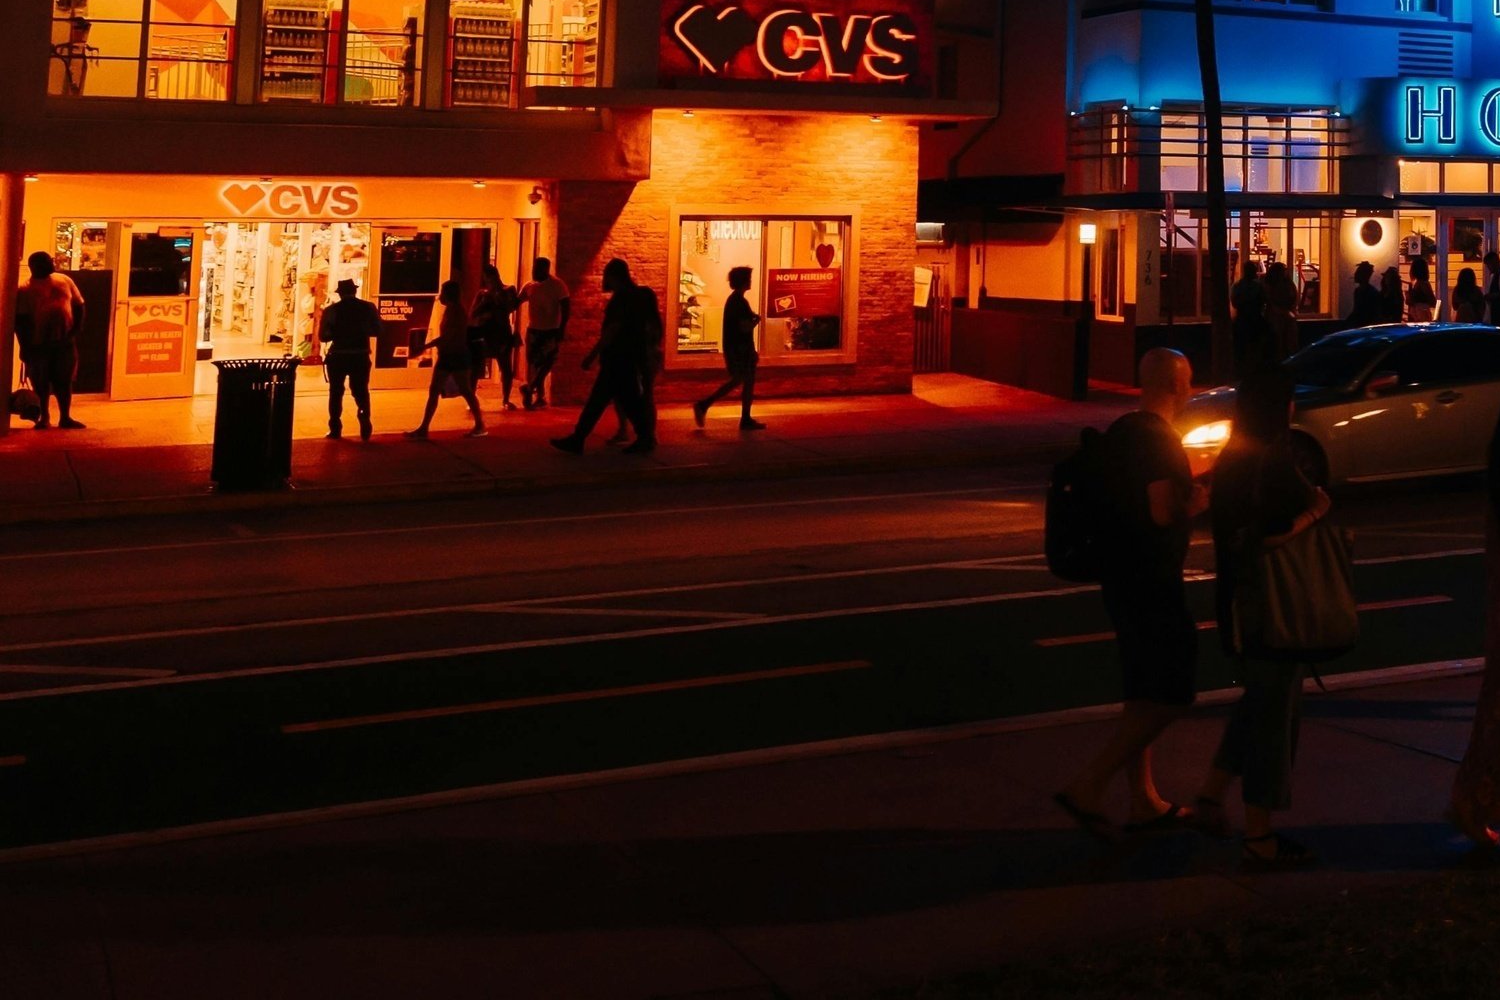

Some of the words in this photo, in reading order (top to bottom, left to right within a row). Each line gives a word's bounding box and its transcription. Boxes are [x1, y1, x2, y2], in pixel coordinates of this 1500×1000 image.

[757, 8, 918, 80] CVS
[268, 184, 359, 216] CVS
[776, 273, 799, 281] NOW
[800, 272, 834, 281] HIRING
[149, 304, 183, 317] CVS
